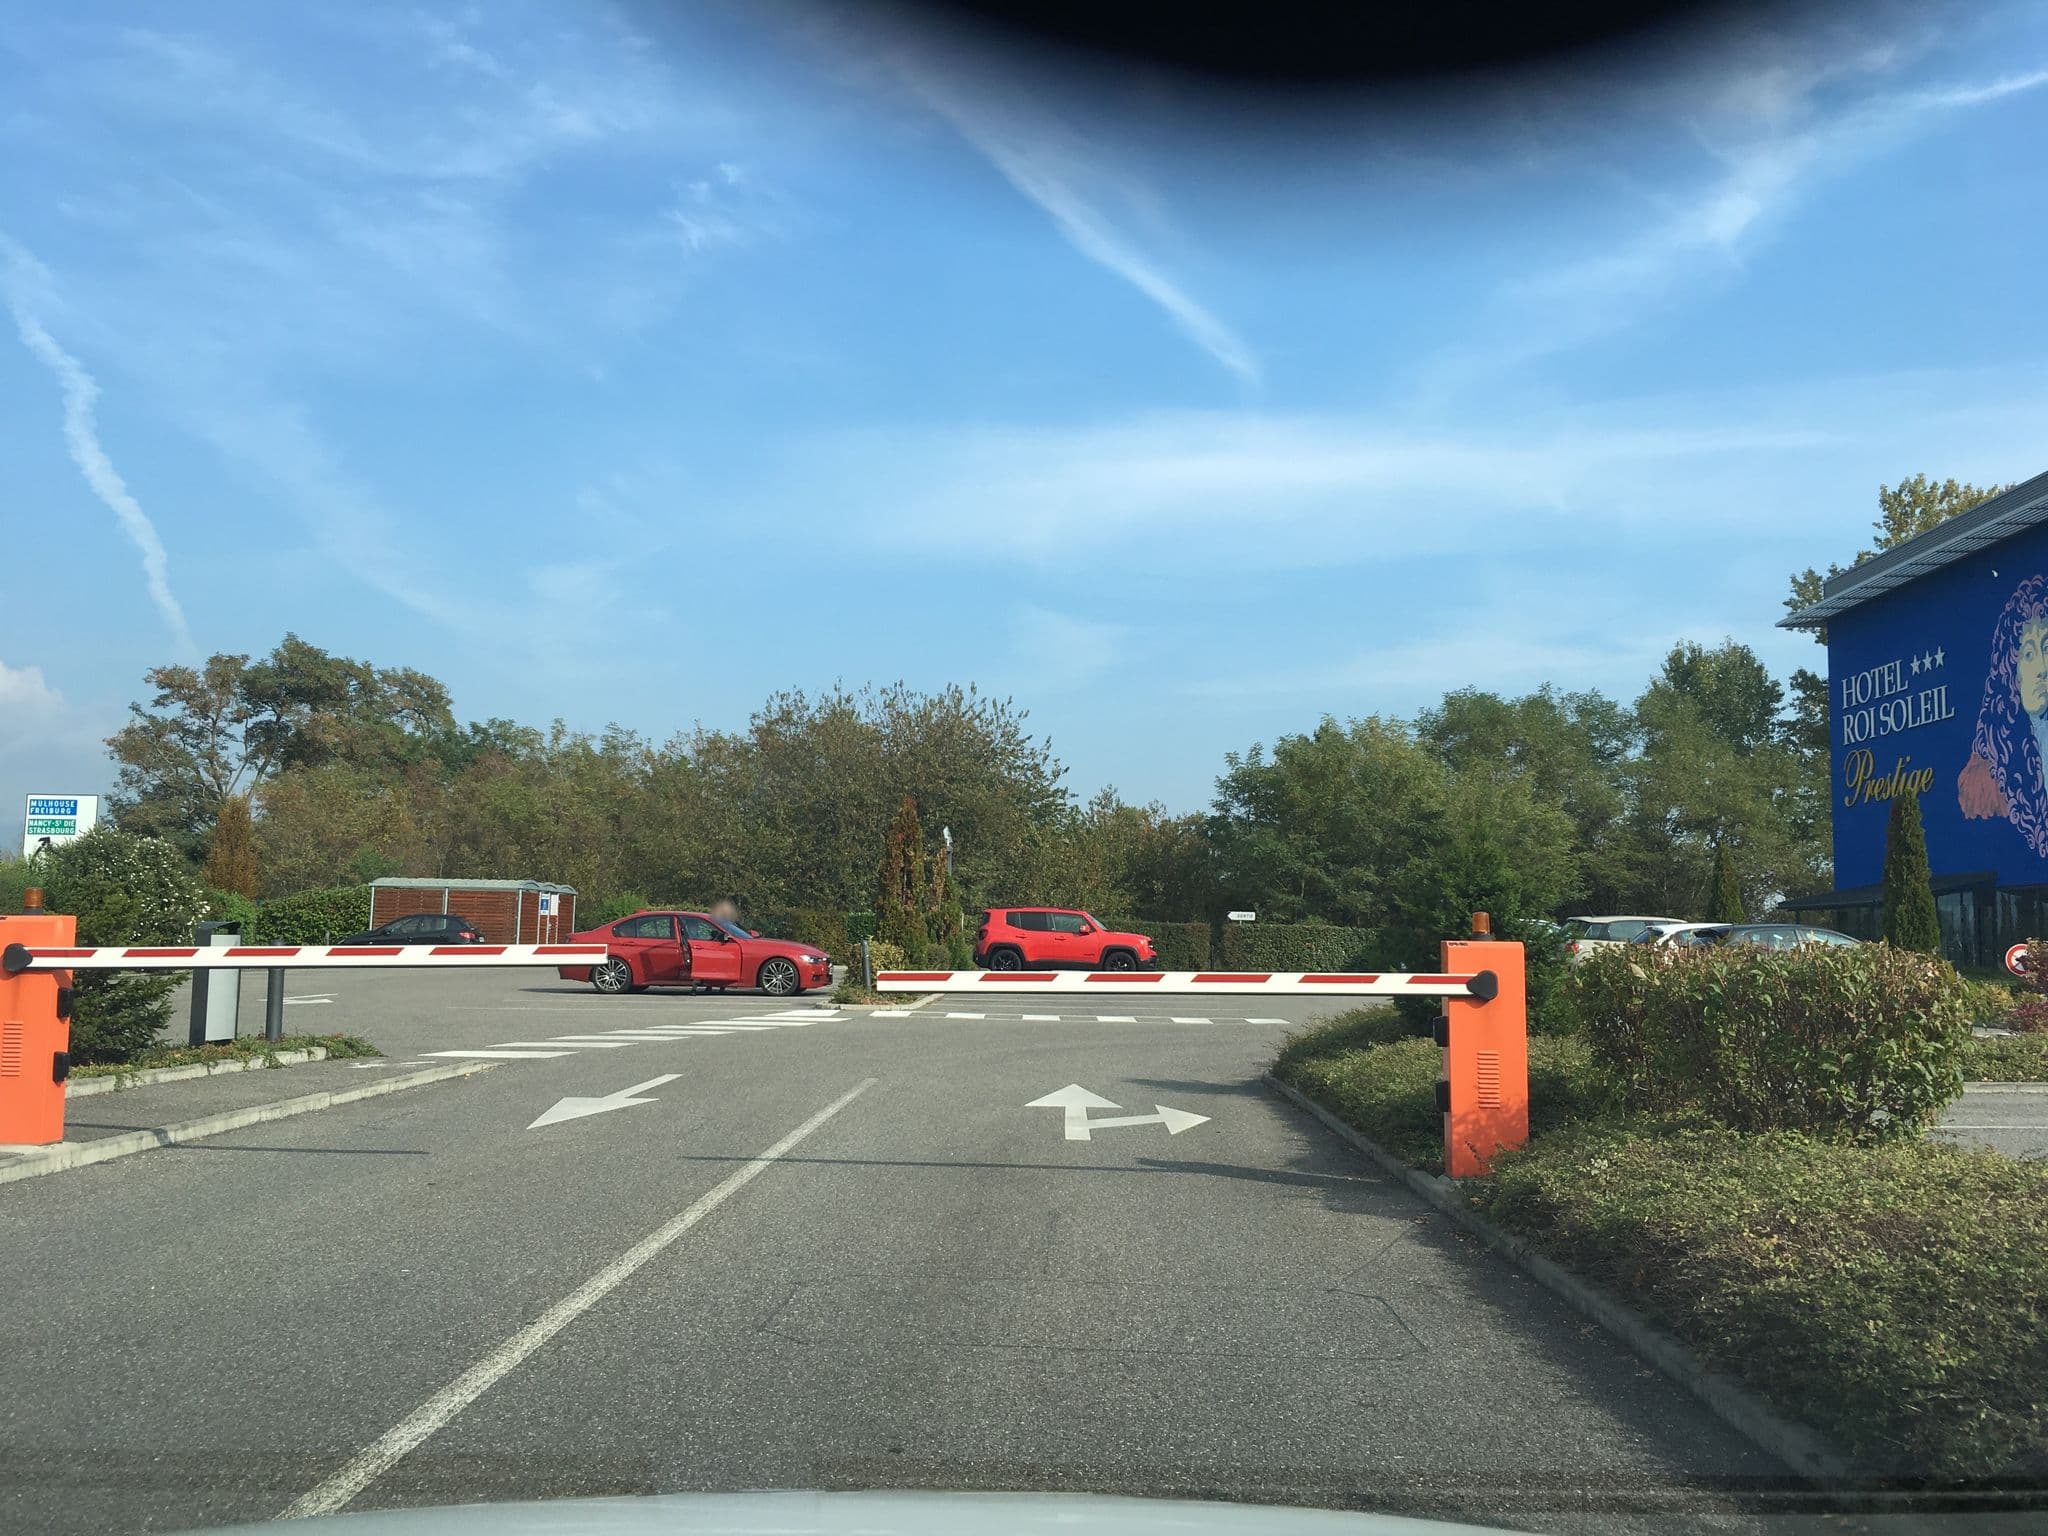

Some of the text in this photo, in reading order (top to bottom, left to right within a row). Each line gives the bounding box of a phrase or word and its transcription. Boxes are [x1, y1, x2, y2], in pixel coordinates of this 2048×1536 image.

[1842, 659, 1908, 709] HOTEL
[1843, 685, 1955, 745] ROI SOLEIL
[30, 800, 75, 808] MULHOUSE
[1843, 748, 1934, 807] Prestige
